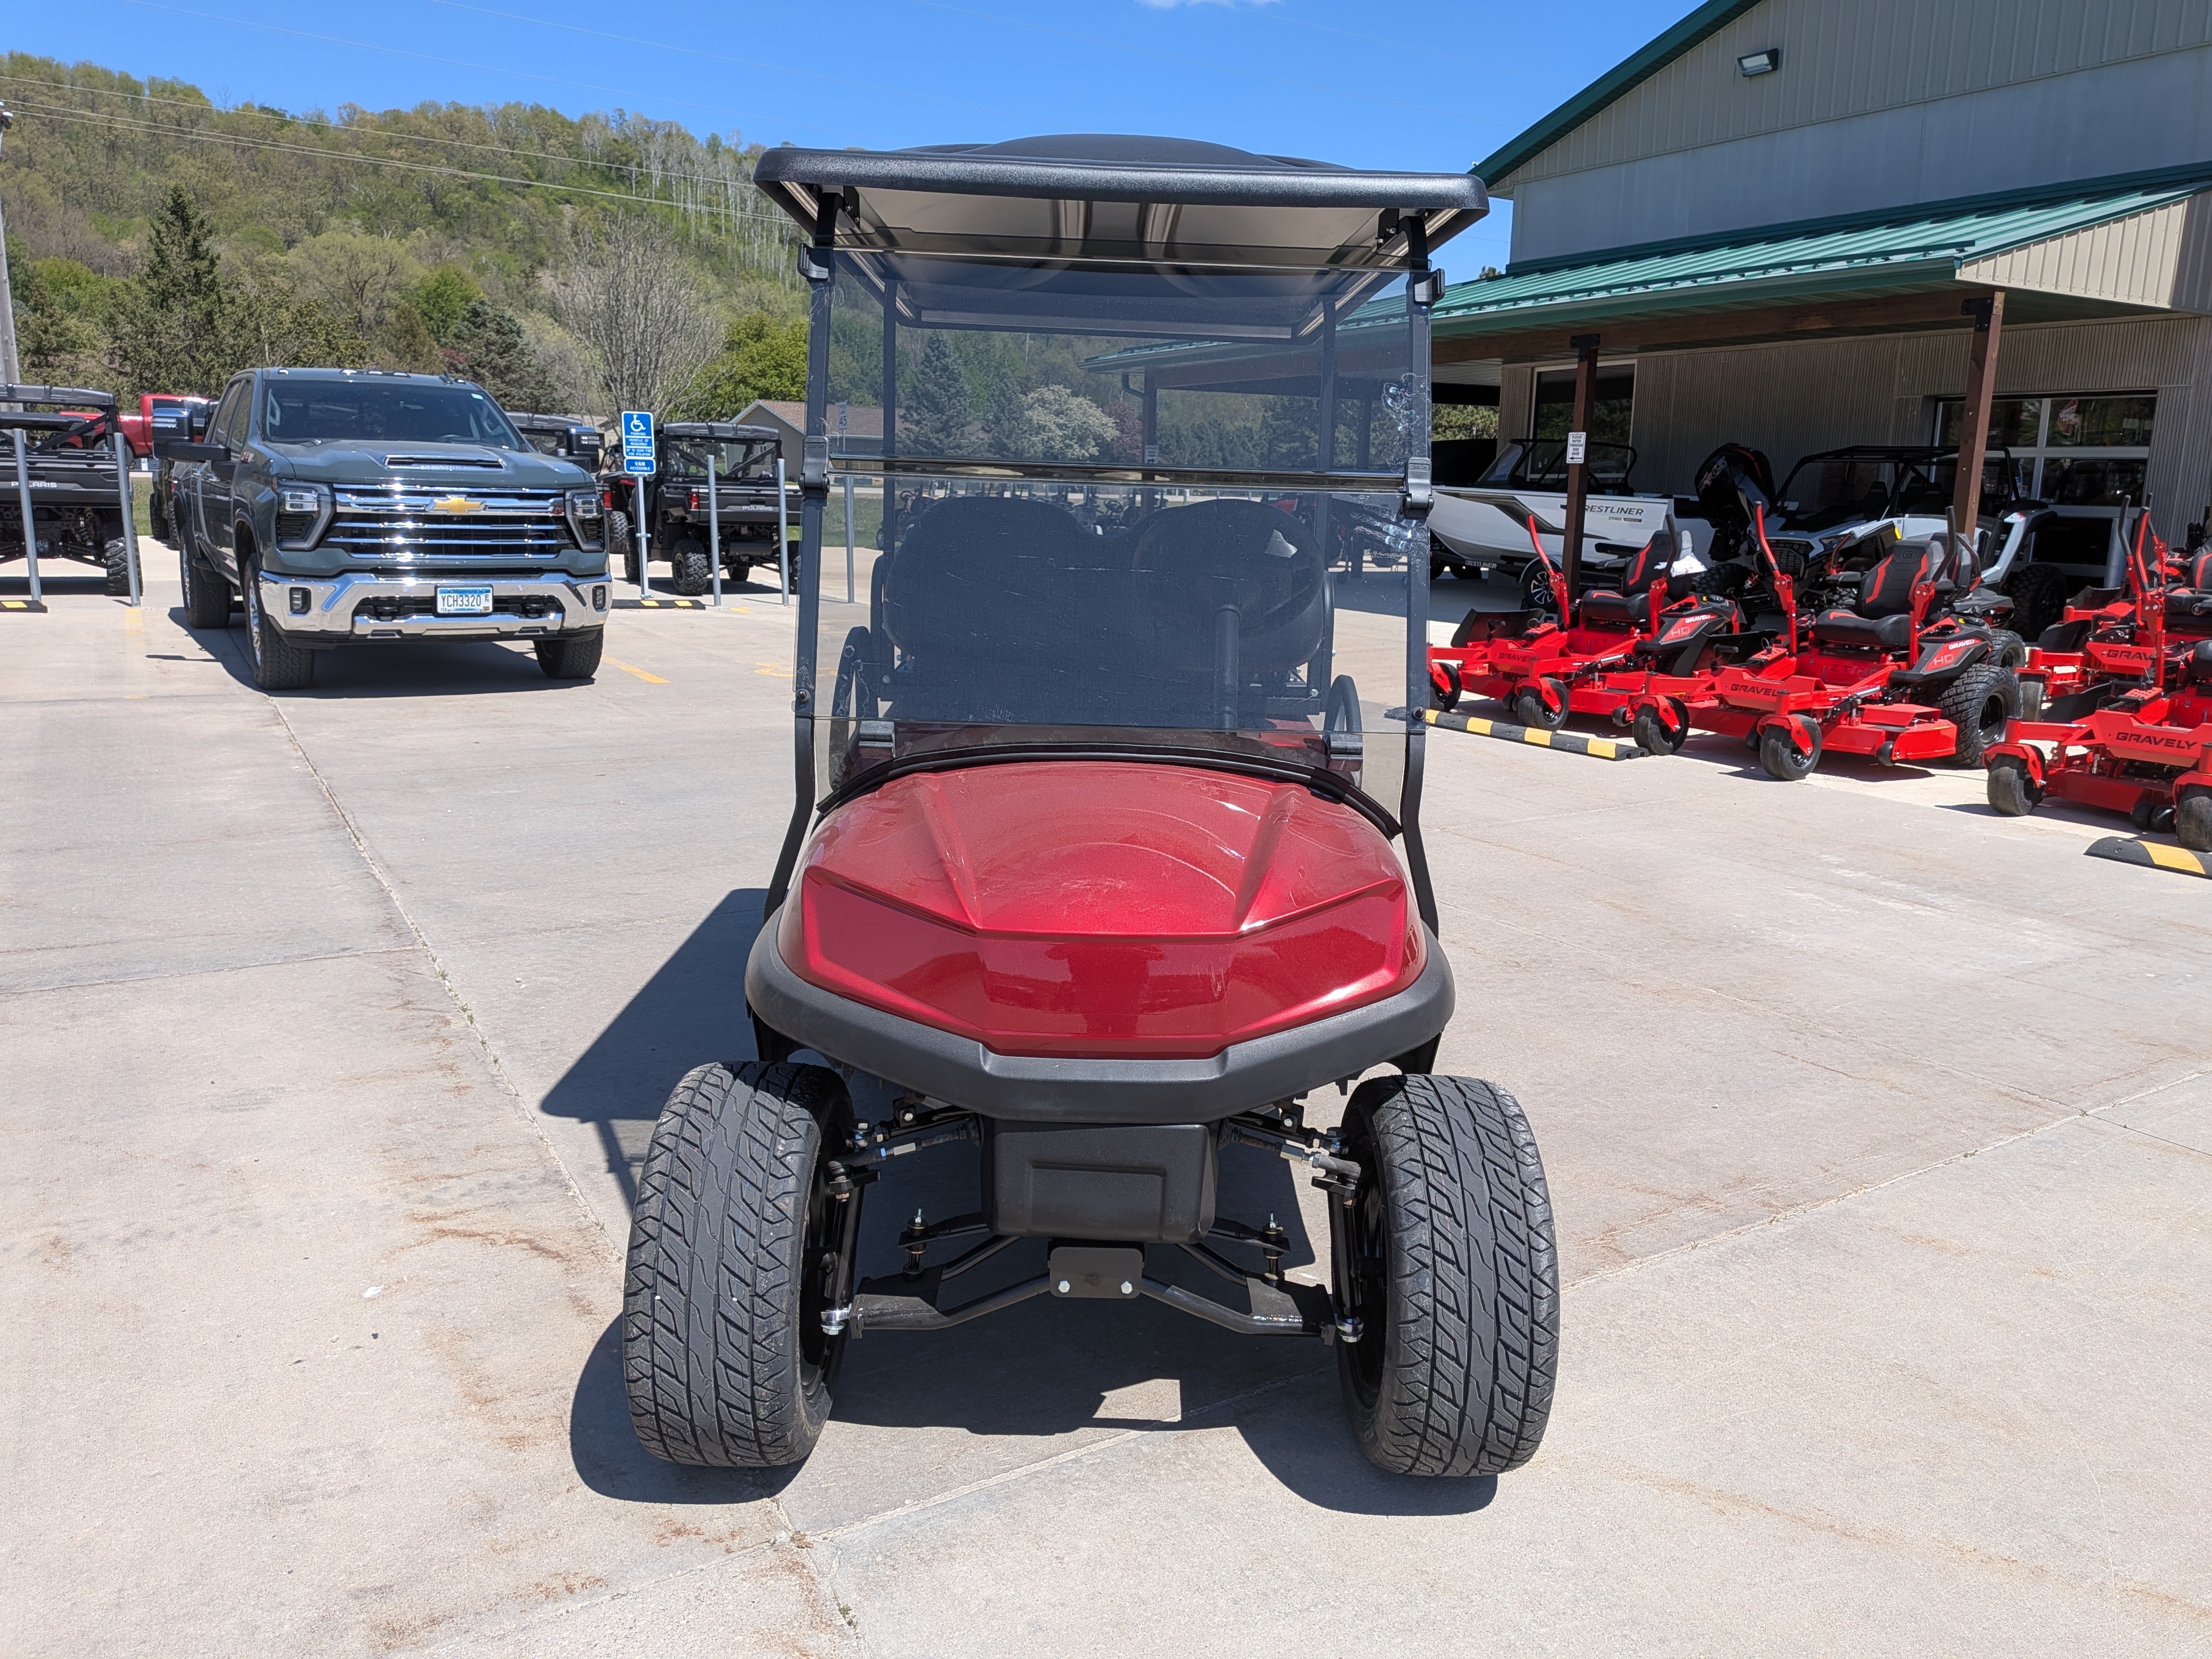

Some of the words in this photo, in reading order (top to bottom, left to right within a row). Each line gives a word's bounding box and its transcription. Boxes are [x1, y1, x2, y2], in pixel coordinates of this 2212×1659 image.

[1585, 505, 1644, 515] RESTLINER
[1465, 560, 1498, 569] CRESTLINER
[441, 594, 481, 607] YCH3320
[1948, 639, 1975, 650] GRAVELY
[1498, 653, 1531, 663] GRAVE
[1933, 654, 1954, 665] HD
[2106, 649, 2153, 661] GRAV
[1730, 684, 1777, 697] GRAVEL
[2115, 732, 2198, 750] GRAVELY
